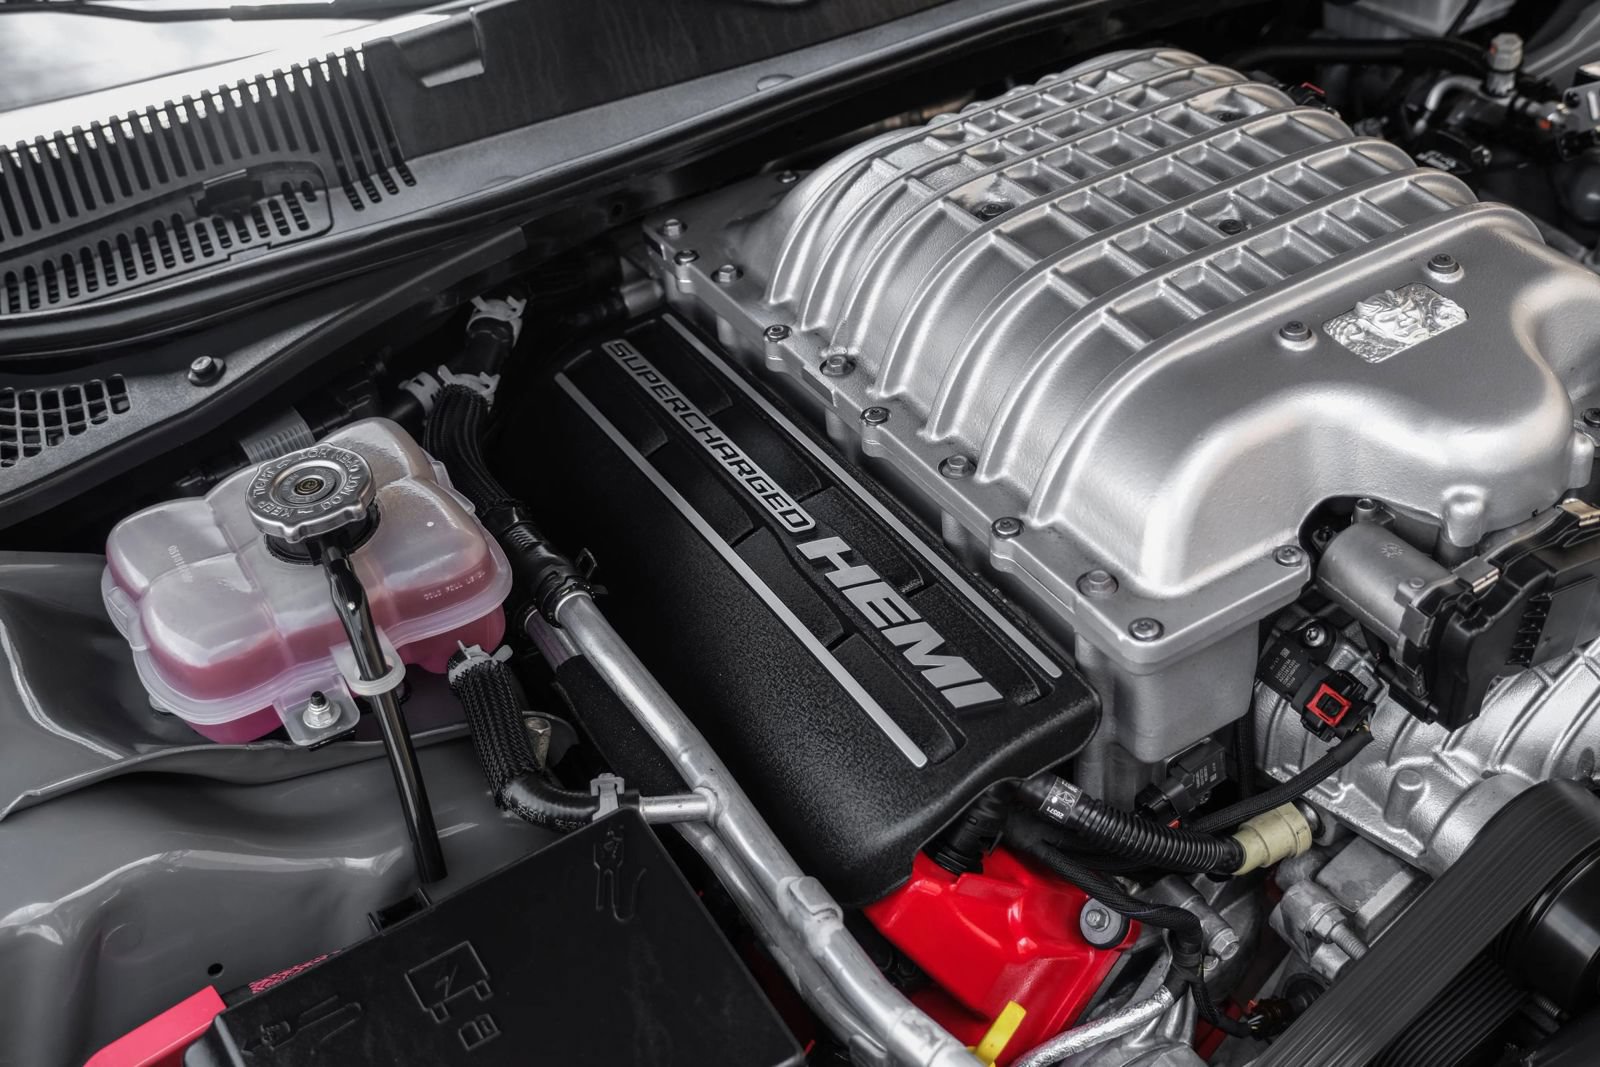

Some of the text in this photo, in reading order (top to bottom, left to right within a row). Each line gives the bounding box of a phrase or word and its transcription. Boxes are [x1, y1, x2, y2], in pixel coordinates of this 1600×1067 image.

[608, 341, 810, 528] SUPERCHARGED
[253, 466, 294, 518] KEEP TIGHT
[321, 497, 343, 510] DO
[341, 476, 360, 497] NOT
[796, 536, 1004, 709] HEMI
[1046, 805, 1065, 819] 20571
